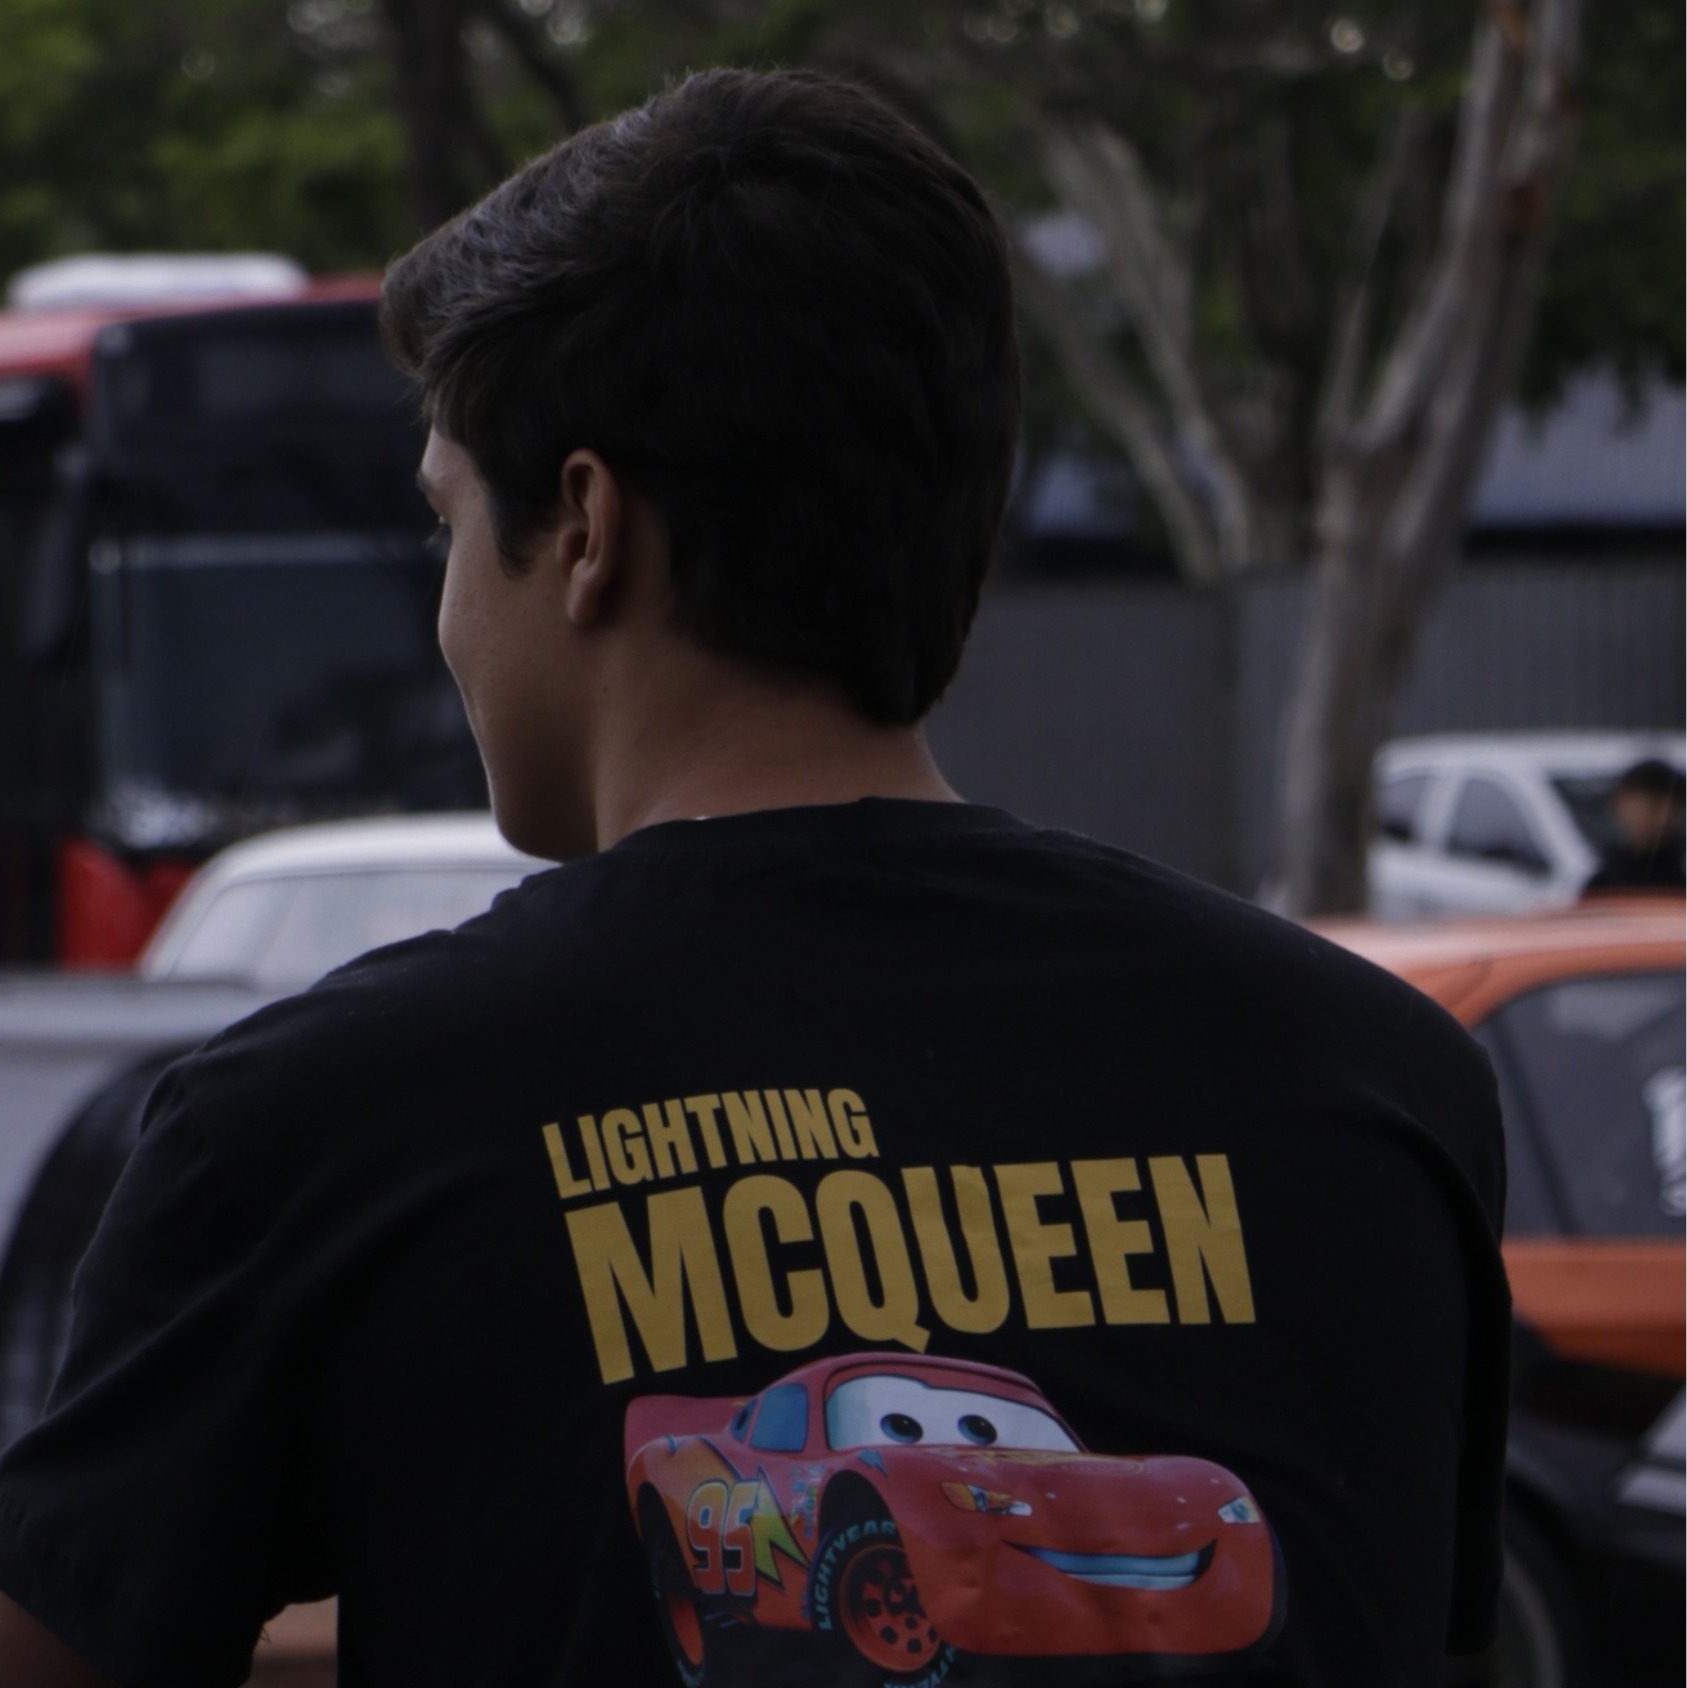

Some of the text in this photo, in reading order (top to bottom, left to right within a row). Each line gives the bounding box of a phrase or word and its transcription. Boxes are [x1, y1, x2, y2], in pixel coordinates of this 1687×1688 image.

[542, 1088, 879, 1199] LIGHTNING
[564, 1153, 1256, 1384] MCQUEEN
[687, 1480, 760, 1597] 95
[815, 1520, 898, 1631] LIGHTYEAR
